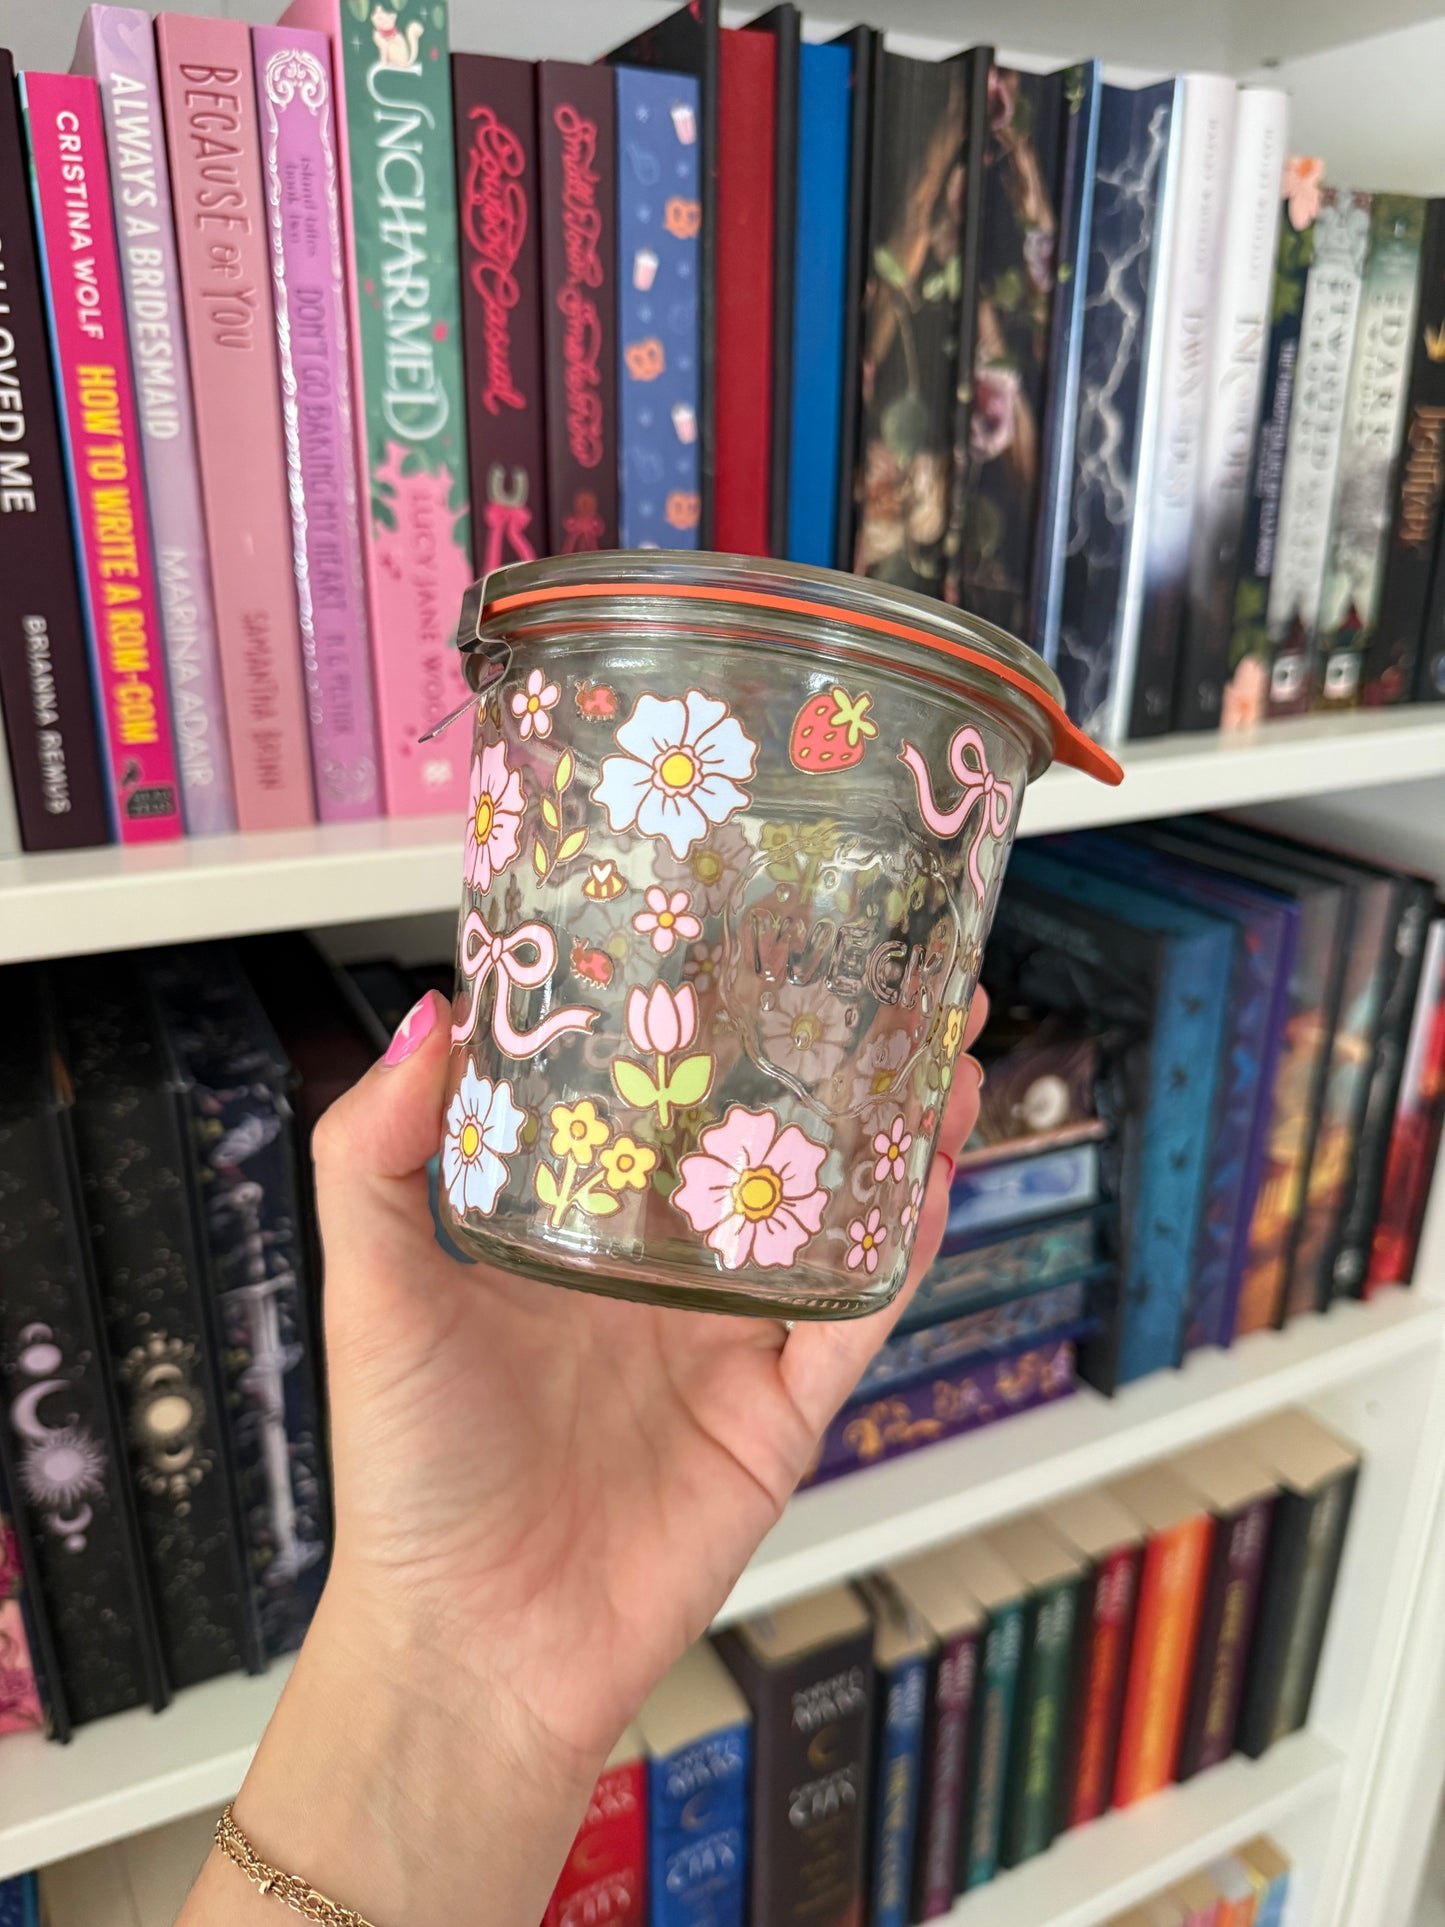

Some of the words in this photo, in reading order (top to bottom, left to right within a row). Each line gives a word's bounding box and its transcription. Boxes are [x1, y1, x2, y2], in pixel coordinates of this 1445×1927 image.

[55, 110, 93, 251] CRISTINA
[110, 72, 158, 208] ALWAYS
[179, 62, 253, 237] BECAUSE
[127, 216, 150, 238] A
[461, 106, 528, 272] Cowboy
[366, 61, 449, 441] UNCHARMED
[73, 259, 104, 340] WOLF
[201, 287, 259, 352] YOU
[296, 289, 329, 361] DON'T
[470, 261, 528, 415] Casual
[127, 248, 181, 440] BRIDESMAID
[301, 364, 332, 399] GO
[77, 364, 123, 437] HOW
[0, 453, 37, 513] ME
[87, 440, 128, 481] TO
[304, 404, 337, 498] BAKING
[92, 485, 140, 577] WRITE
[310, 501, 338, 538] MY
[408, 488, 438, 572] LUCY
[104, 582, 142, 606] A
[159, 546, 202, 688] MARINA
[314, 541, 346, 612] HEART
[410, 574, 441, 642] JANE
[22, 614, 60, 726] BRIANNA
[108, 607, 159, 746] ROM-COM
[36, 728, 72, 815] REMUS
[173, 688, 215, 787] ADAIR
